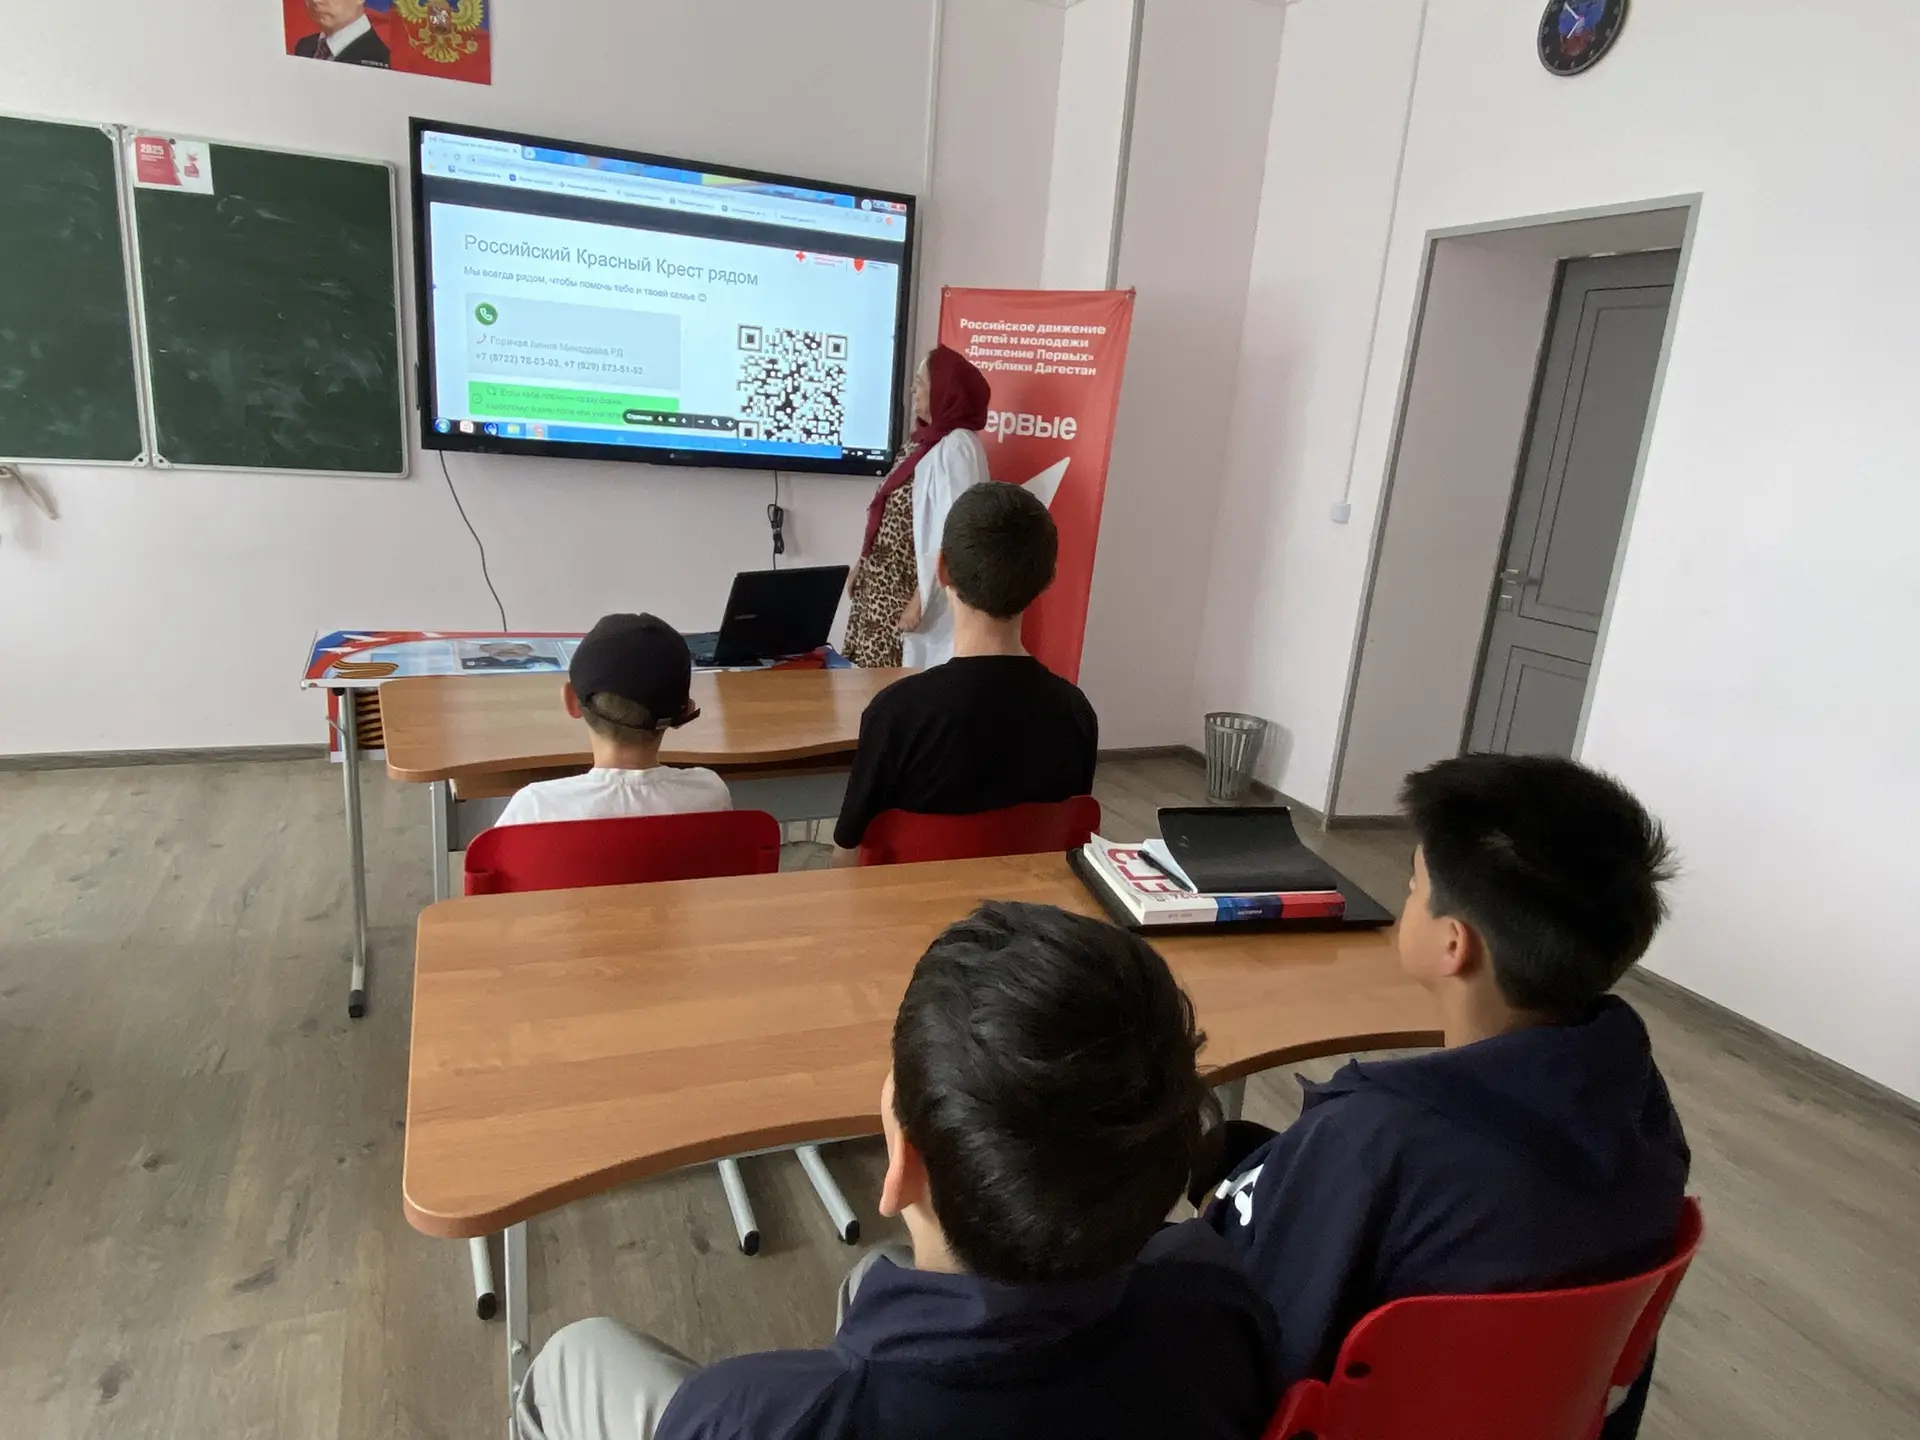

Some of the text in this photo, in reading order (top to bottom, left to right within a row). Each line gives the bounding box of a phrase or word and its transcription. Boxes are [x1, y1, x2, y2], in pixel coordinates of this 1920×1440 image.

[464, 233, 759, 286] Российский Красный Крест рядом
[463, 265, 481, 276] Мы
[482, 269, 514, 280] всегда
[515, 272, 548, 285] рядом,
[549, 276, 578, 287] чтобы
[579, 280, 612, 291] помочь
[614, 283, 634, 294] тебе
[644, 287, 669, 298] твоей
[670, 291, 696, 301] семье
[959, 317, 1106, 335] Российское движение
[490, 335, 528, 348] Горячая
[530, 340, 557, 351] линия
[970, 333, 1089, 348] детей и молодежи
[476, 352, 487, 361] +7
[564, 360, 575, 368] +7
[964, 345, 1094, 362] «Движение Первых»
[968, 359, 1097, 376] еспублики Дагестан
[983, 409, 1078, 443] ервые
